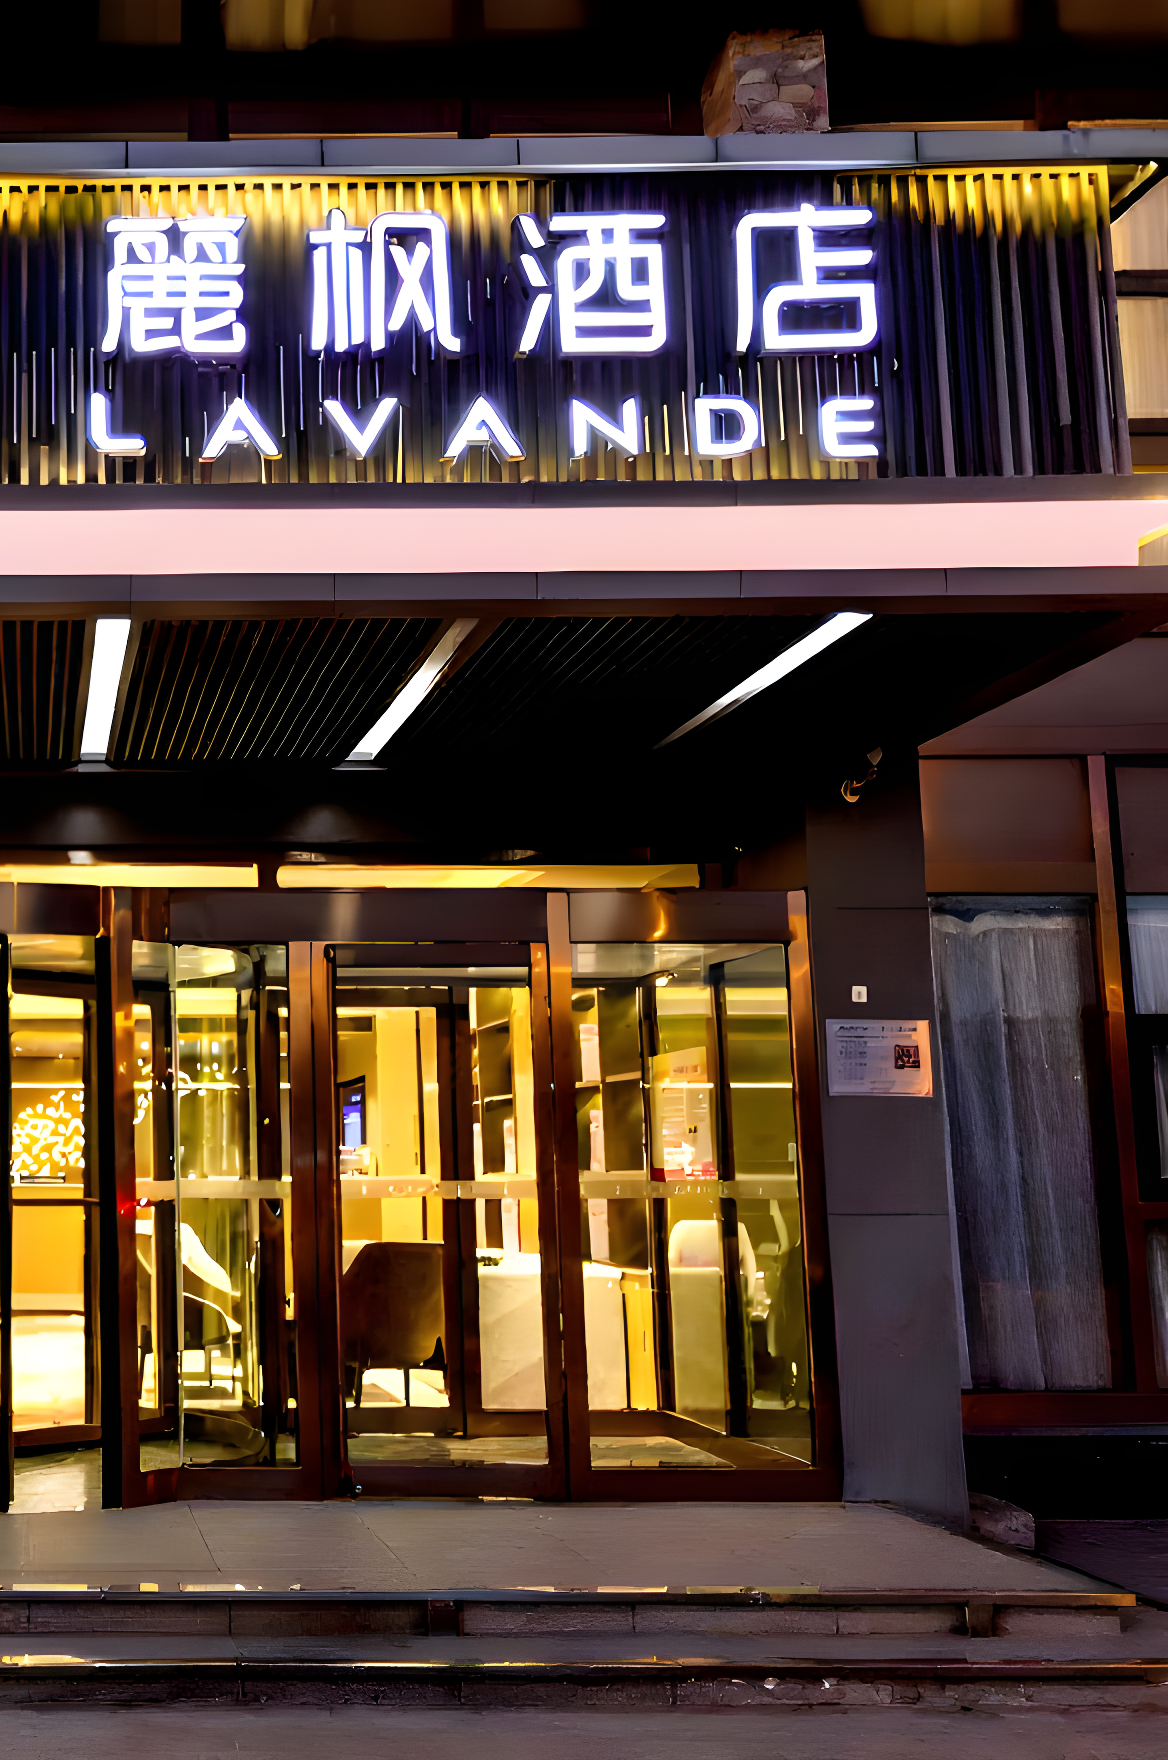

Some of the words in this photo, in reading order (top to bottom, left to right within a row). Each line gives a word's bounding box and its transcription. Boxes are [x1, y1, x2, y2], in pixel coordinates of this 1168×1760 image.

[101, 203, 880, 355] 麗枫酒店
[89, 392, 881, 462] LAVANDE
